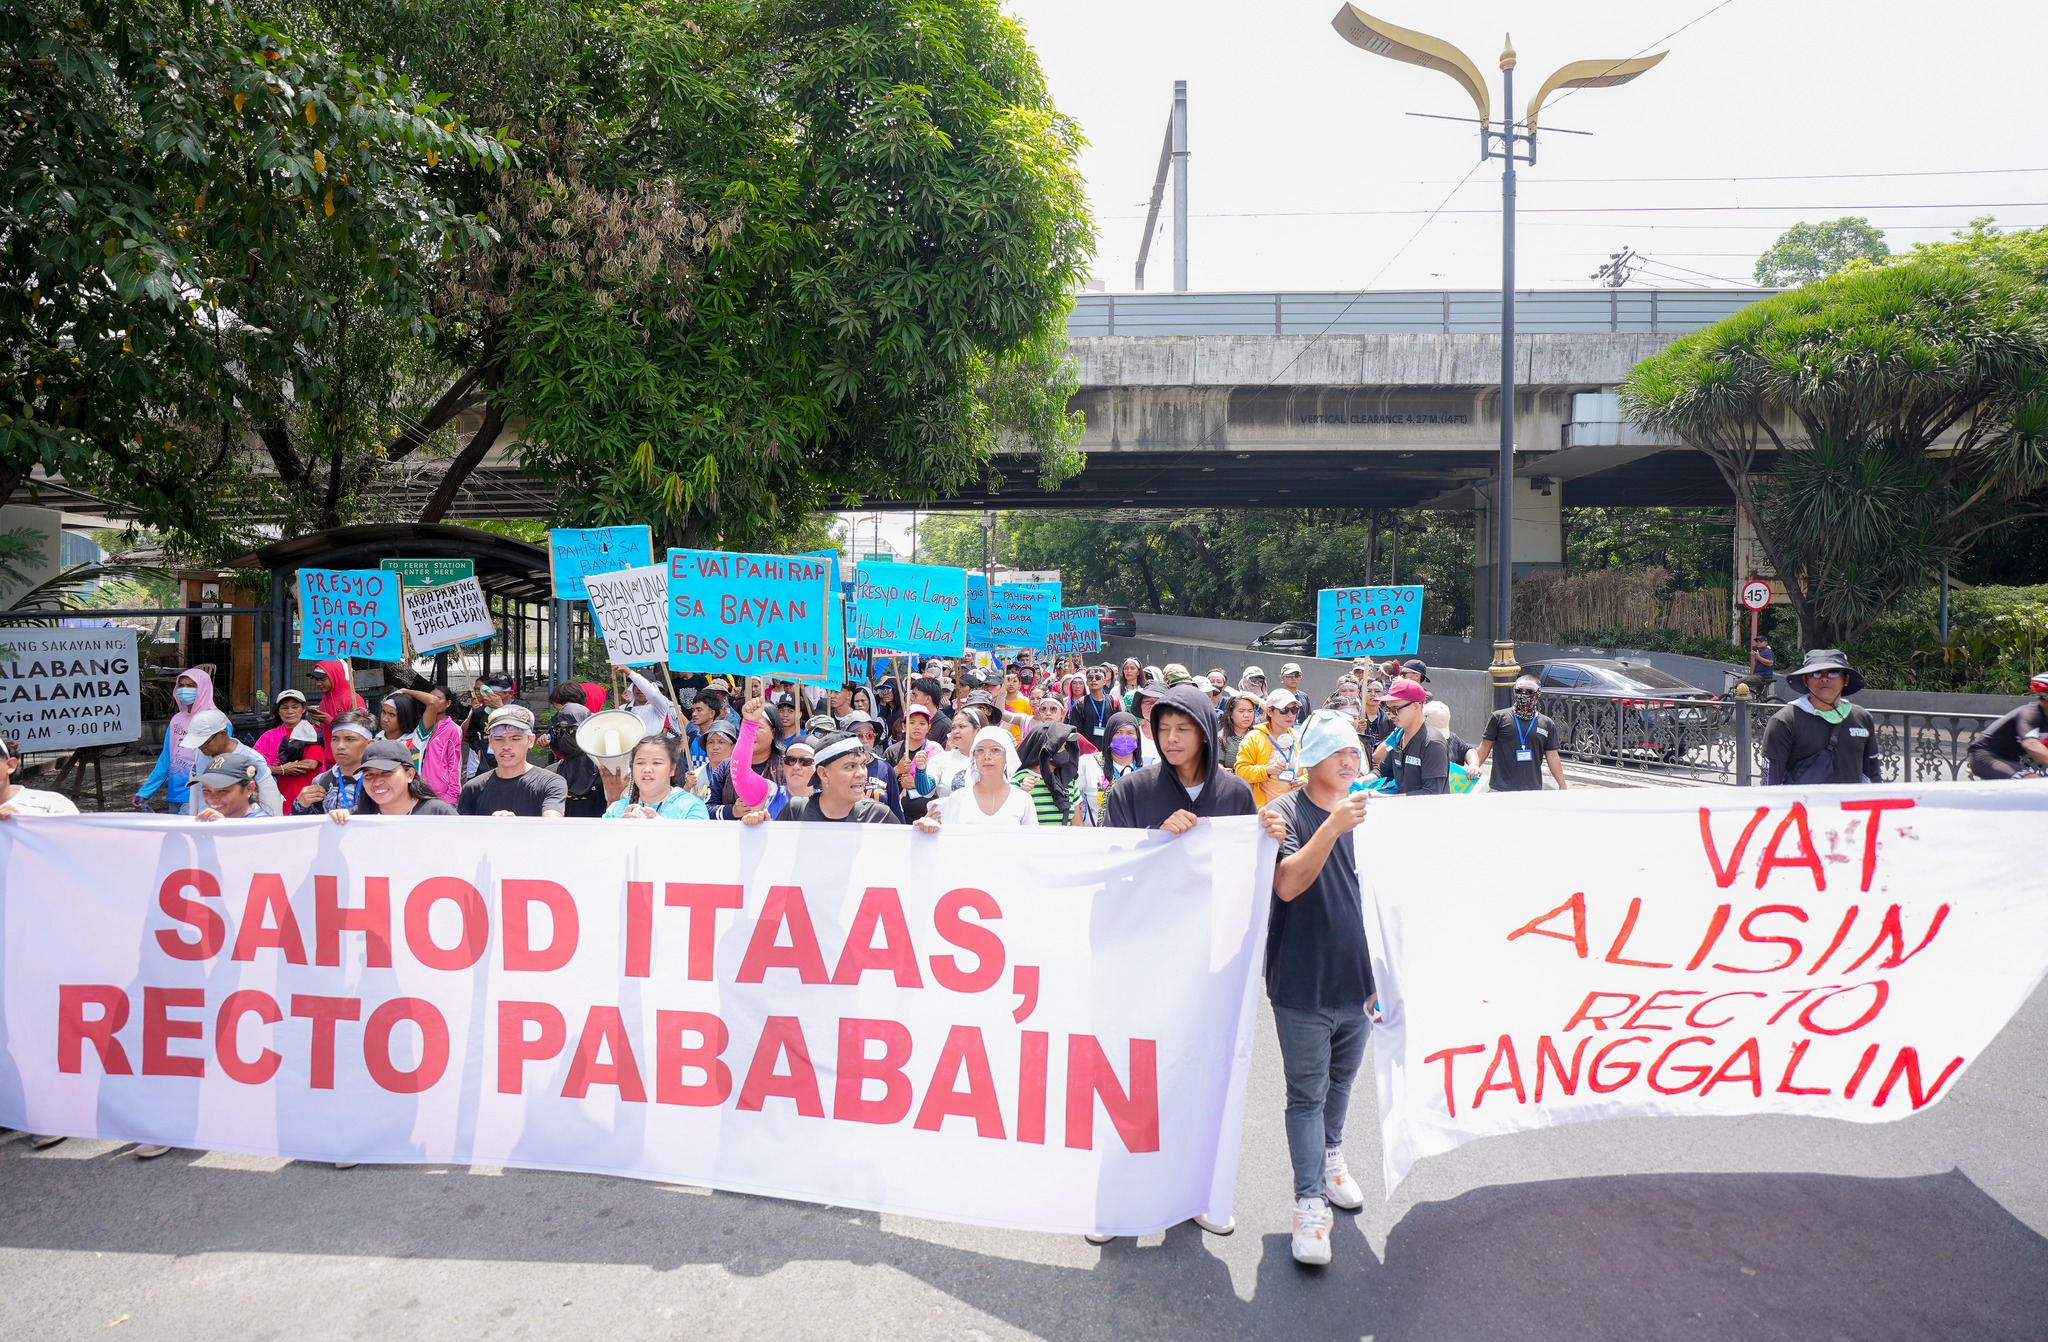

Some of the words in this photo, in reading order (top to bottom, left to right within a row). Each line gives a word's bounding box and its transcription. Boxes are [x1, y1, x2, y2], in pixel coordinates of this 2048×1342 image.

[1300, 414, 1346, 424] VERTICAL
[1350, 414, 1403, 424] CLEARANCE
[618, 540, 640, 555] SA
[580, 556, 628, 574] BAYAN
[305, 572, 383, 597] PRESYO
[587, 579, 635, 609] BAYAN
[631, 580, 640, 593] AY
[311, 595, 378, 617] IBABA
[903, 588, 917, 602] NG
[922, 579, 959, 612] Langis
[993, 601, 1003, 610] SA
[1006, 602, 1032, 611] BAYAN
[1003, 591, 1044, 602] PAHIRAP
[1336, 588, 1415, 606] PRESYO
[412, 591, 482, 622] MAMAMAYAN
[675, 595, 706, 618] SA
[720, 593, 807, 628] BAYAN
[1048, 608, 1096, 621] ARAPATAN
[1335, 603, 1405, 623] IBABA
[313, 617, 389, 639] SAHOD
[415, 606, 487, 636] IPAGLABAN
[908, 613, 959, 643] Ibaba!
[993, 626, 1030, 637] BASURA
[1062, 620, 1077, 631] NG
[1333, 617, 1399, 639] SAHOD
[42, 640, 101, 652] SAKAYAN
[105, 639, 127, 650] NG:
[608, 637, 618, 651] AY
[1047, 629, 1097, 644] AMAMAYAN
[1332, 636, 1386, 655] ITAAS
[41, 704, 121, 720] MAYAPA)
[27, 726, 51, 740] AM
[67, 722, 98, 736] 9:00
[103, 720, 122, 733] PM
[1699, 797, 1917, 893] VAT
[1506, 892, 1951, 977] ALISIN
[155, 868, 580, 973] SAHOD
[625, 881, 1040, 1025] ITAAS,
[1562, 979, 1890, 1037] RECTO
[57, 984, 450, 1094] RECTO
[497, 1000, 1160, 1154] PABABAIN
[1423, 1033, 1965, 1119] TANGGALIN
